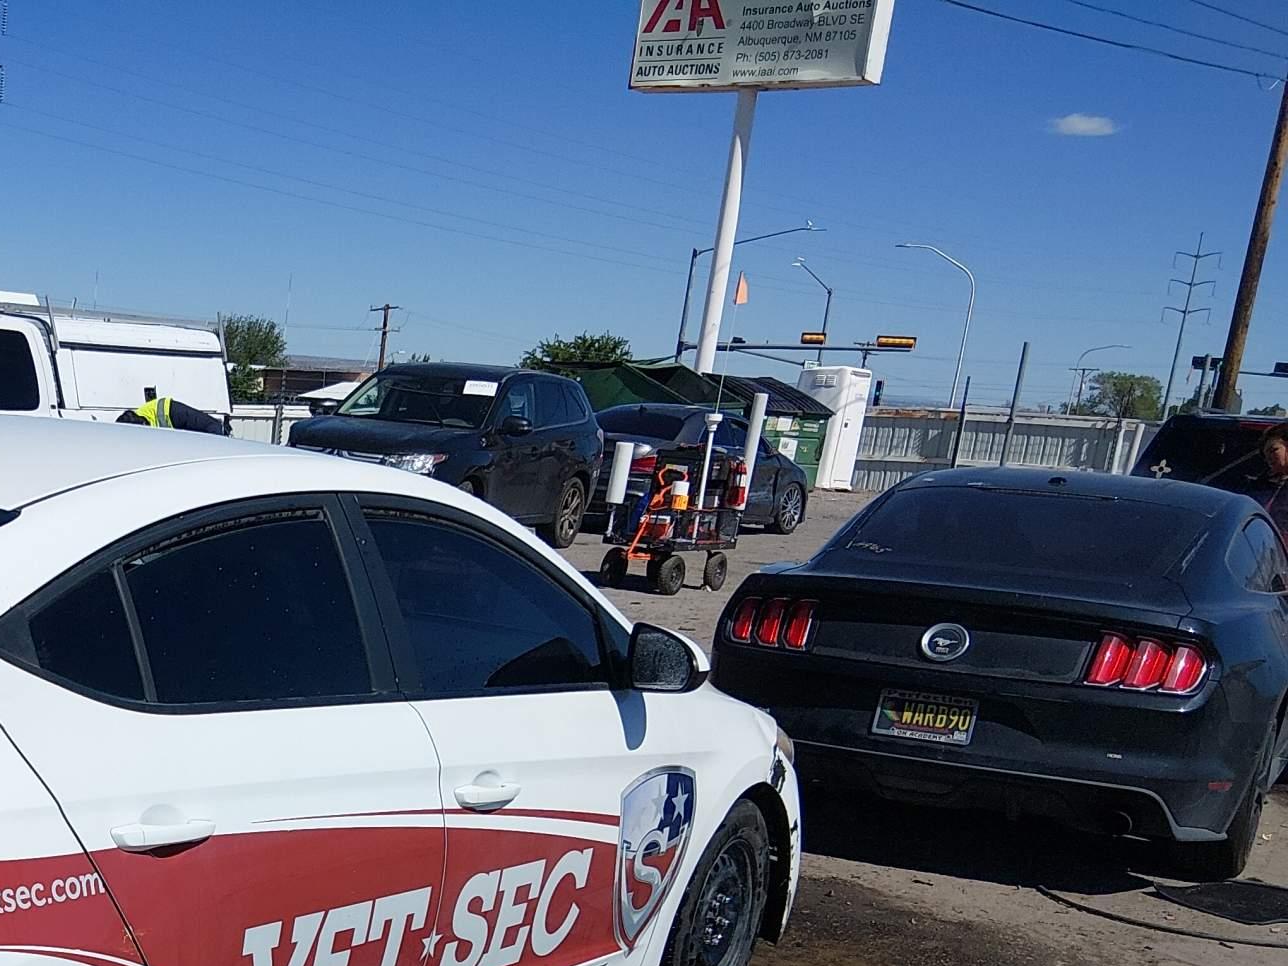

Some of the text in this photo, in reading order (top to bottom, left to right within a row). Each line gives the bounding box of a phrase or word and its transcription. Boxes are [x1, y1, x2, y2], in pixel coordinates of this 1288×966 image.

[742, 0, 872, 16] Insurance Auto Auctions
[740, 13, 865, 31] 4400 Broadway BLVD SE
[738, 30, 857, 47] Albuquerque, NM 87105
[639, 42, 724, 57] INSURANCE
[735, 49, 829, 64] Ph: (505) 873-2081
[636, 62, 721, 77] AUTO AUCTIONS
[732, 66, 799, 78] www.iaai.com
